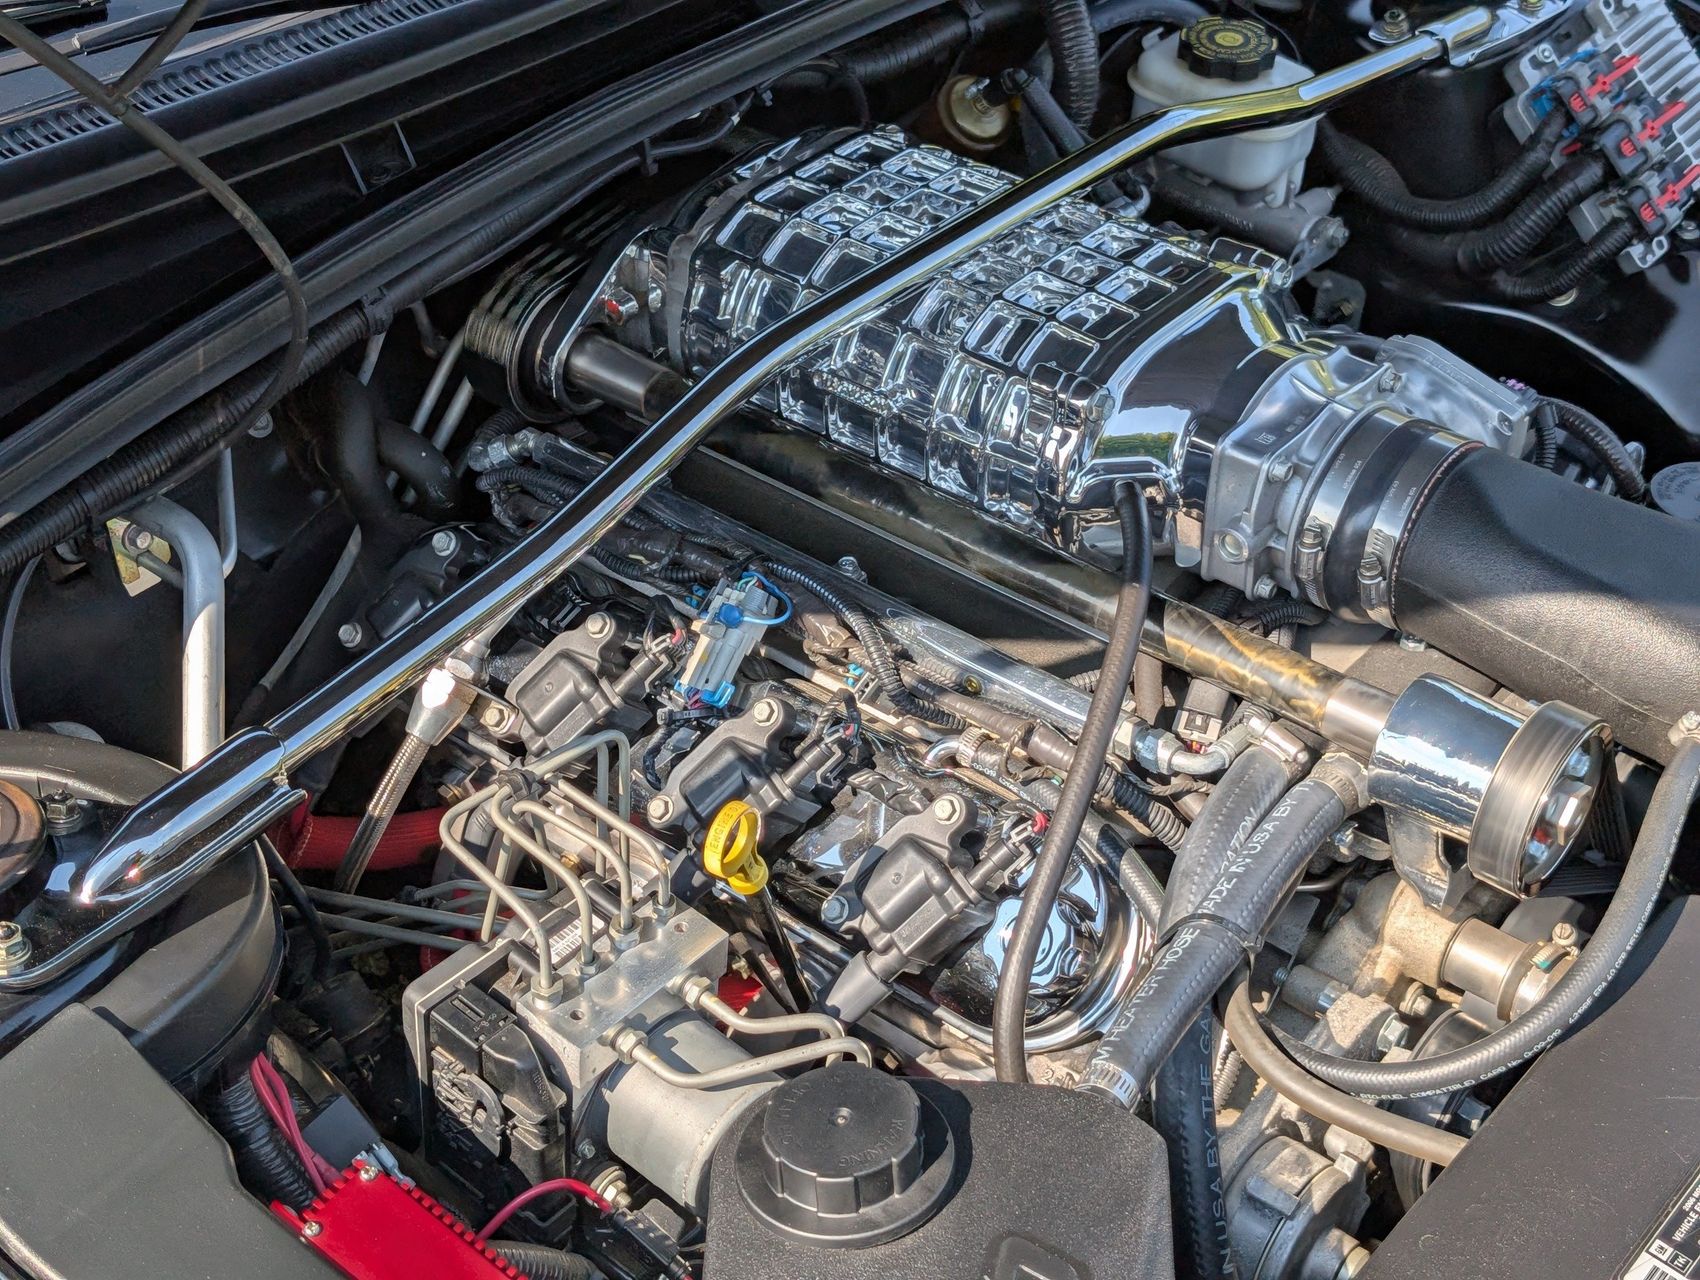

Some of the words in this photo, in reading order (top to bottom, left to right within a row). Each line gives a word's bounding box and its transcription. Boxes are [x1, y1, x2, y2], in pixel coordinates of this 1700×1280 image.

[1107, 975, 1165, 1042] HEATER
[1158, 927, 1200, 970] HOSE
[1242, 821, 1280, 854] USA
[1273, 798, 1297, 817] BY
[1200, 1063, 1214, 1121] THE
[838, 1118, 906, 1168] WARNING
[1205, 1129, 1219, 1168] BY
[1210, 1177, 1228, 1240] USA
[1671, 1211, 1698, 1241] VEHICLE
[1674, 1255, 1687, 1267] TK
